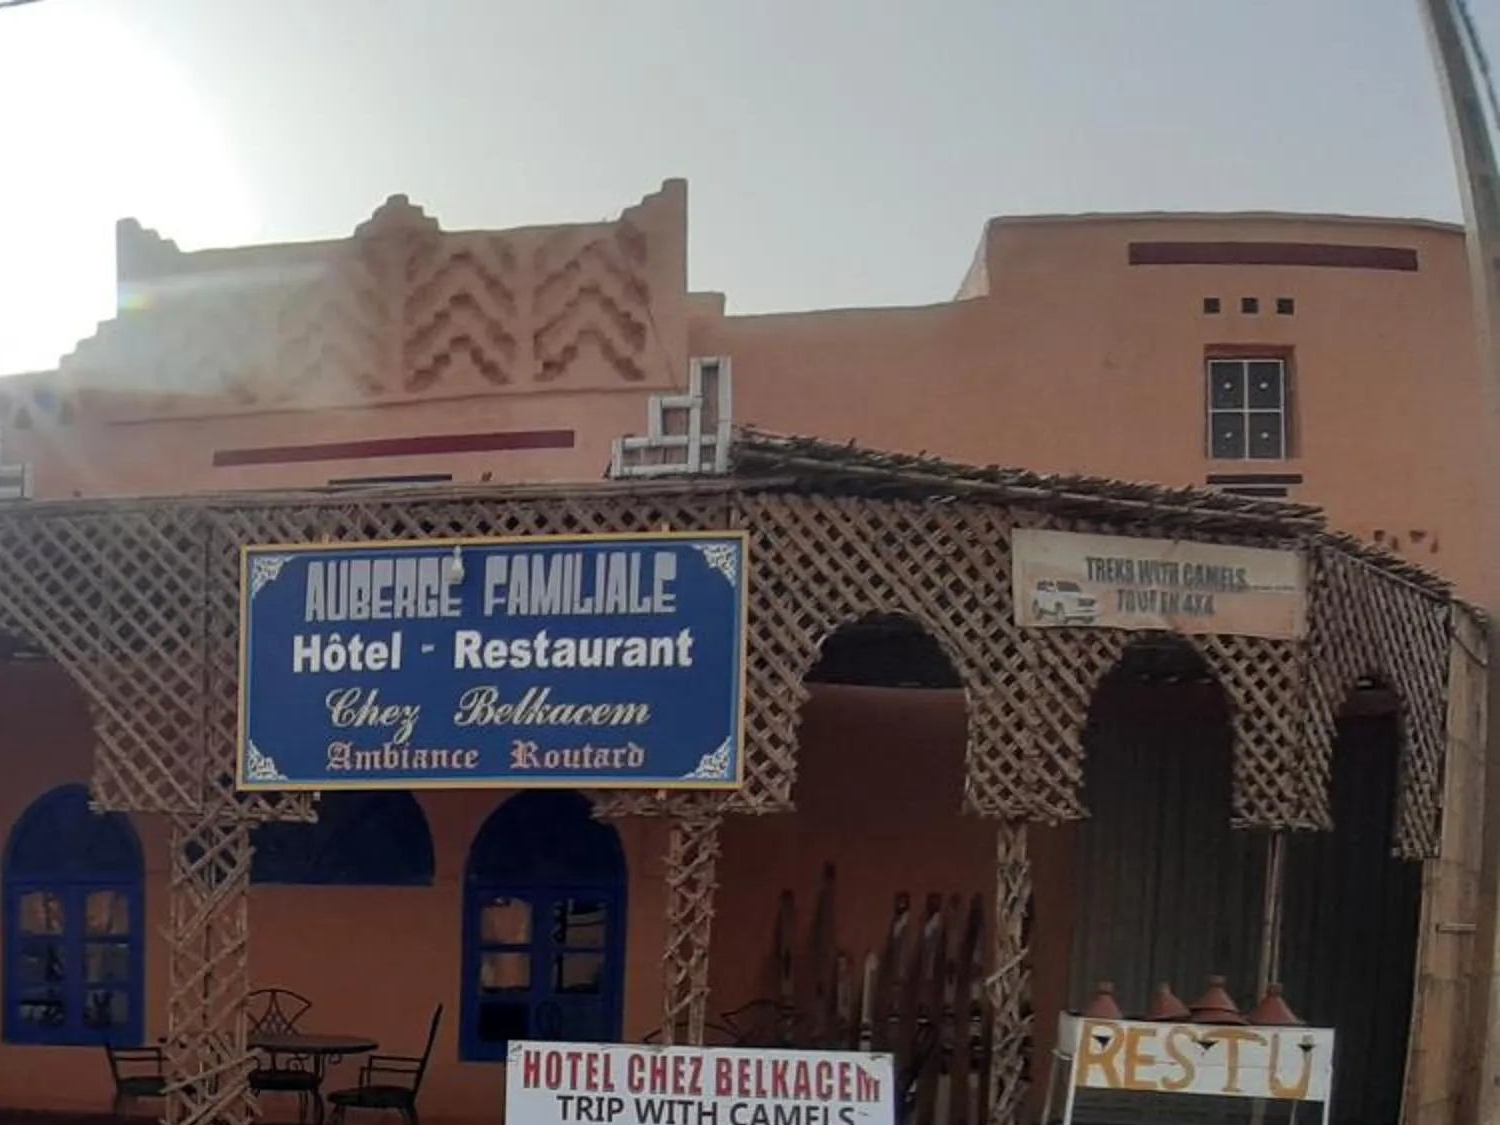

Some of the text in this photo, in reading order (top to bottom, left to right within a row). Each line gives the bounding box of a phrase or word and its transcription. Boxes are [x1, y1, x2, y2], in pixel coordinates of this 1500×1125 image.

[306, 552, 676, 621] AUBERGE FAMILIALE
[293, 632, 400, 672] Hôtel
[454, 627, 694, 669] Restaurant
[326, 686, 650, 742] Chez Belkacem
[326, 739, 645, 771] Ambiance Routard
[523, 1050, 614, 1092] HOTEL
[628, 1053, 704, 1096] CHEZ
[1075, 1020, 1313, 1099] RESTU
[557, 1095, 623, 1123] TRIP
